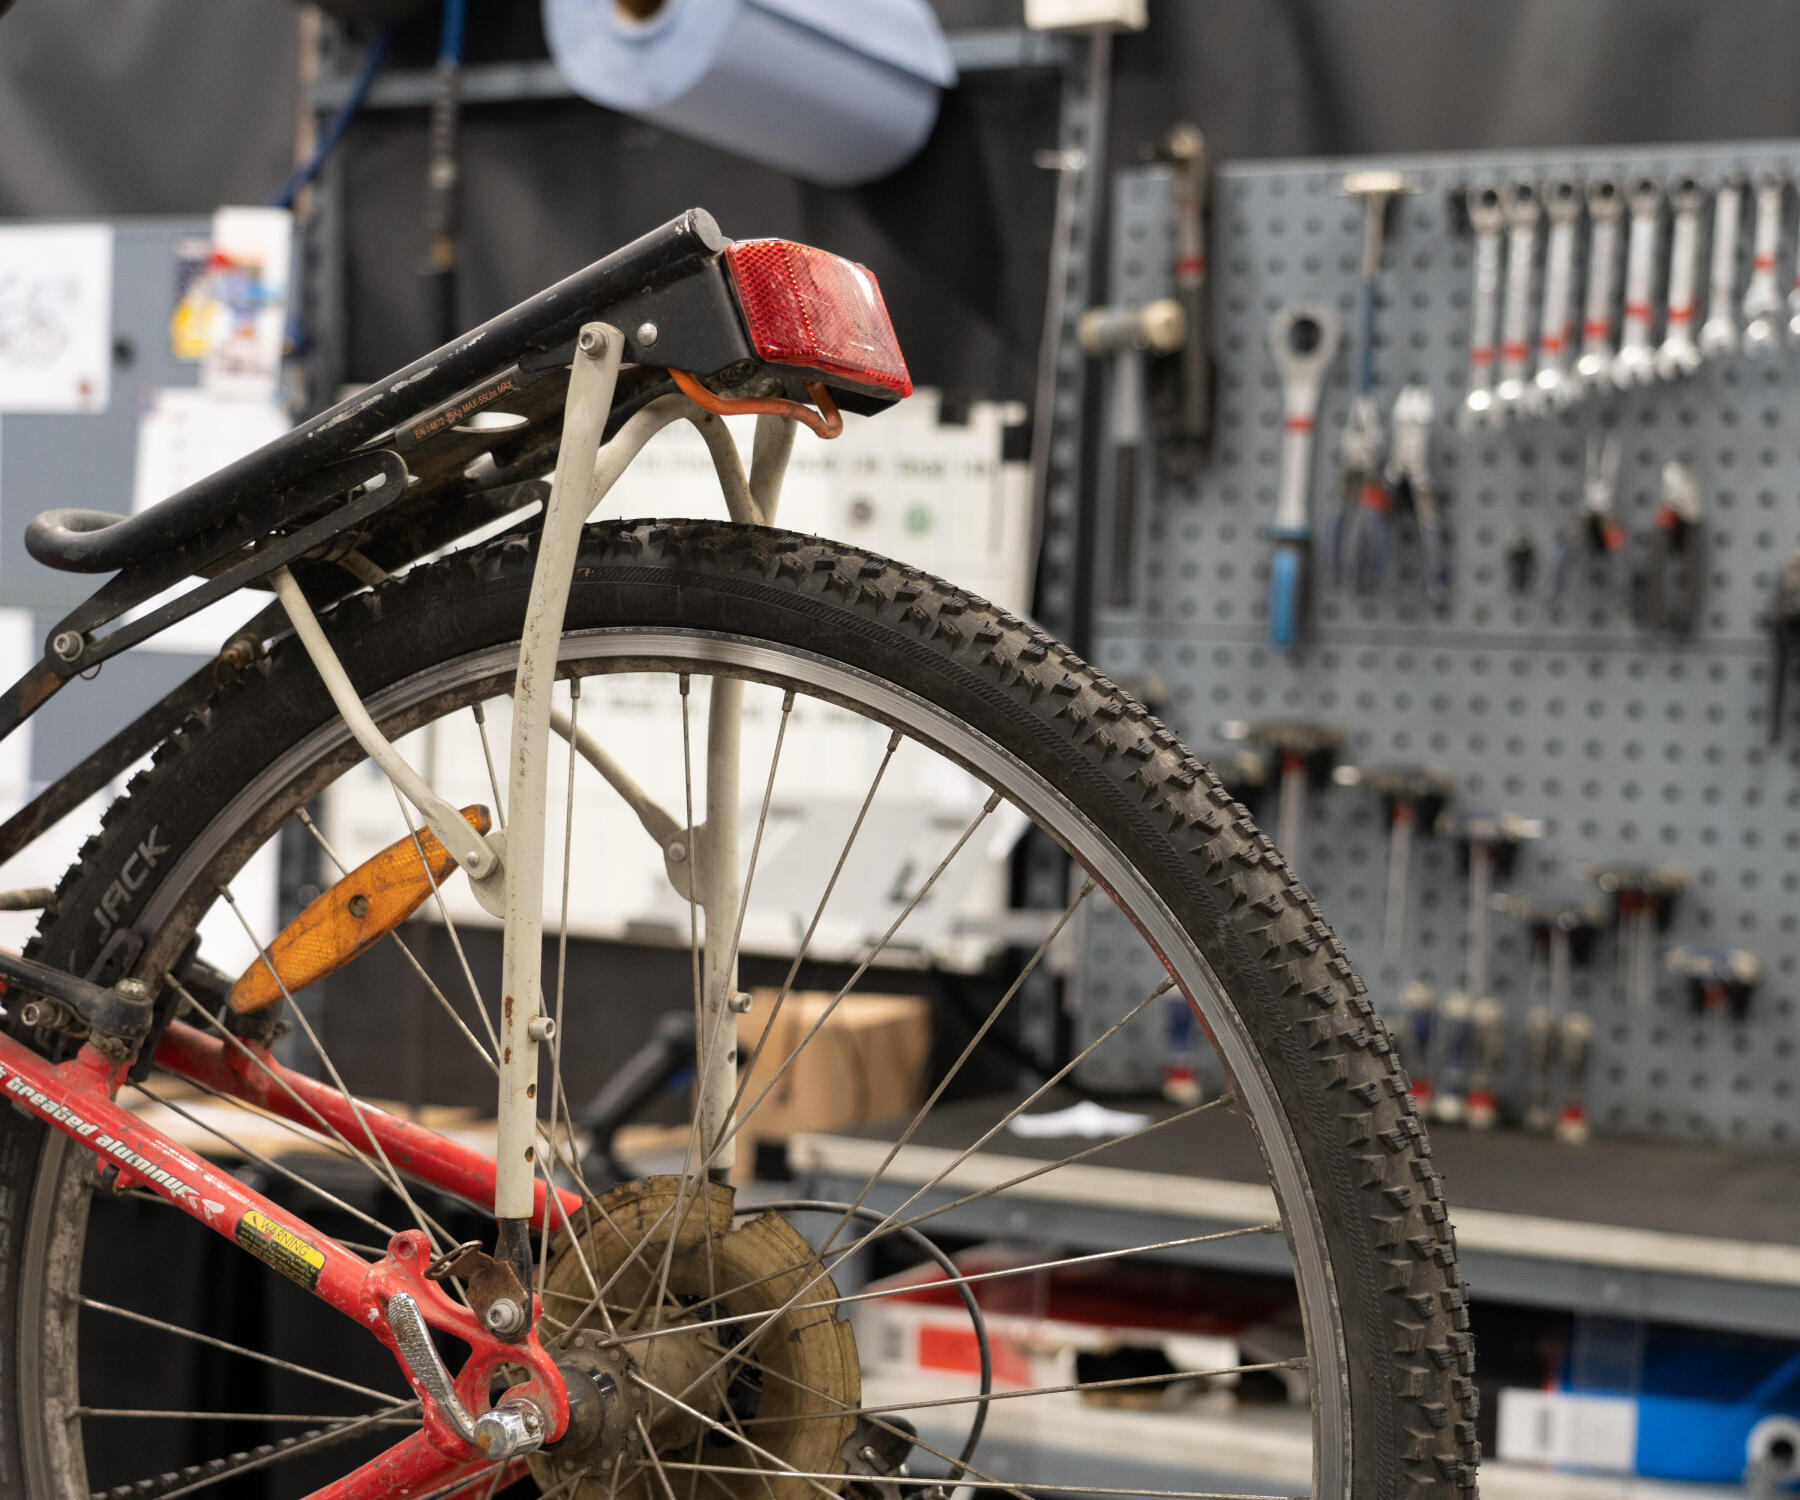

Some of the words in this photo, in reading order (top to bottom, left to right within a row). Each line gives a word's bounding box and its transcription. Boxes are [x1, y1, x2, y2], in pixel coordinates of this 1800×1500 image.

[93, 824, 171, 944] JACK
[5, 1076, 99, 1137] treated
[261, 1218, 310, 1257] WARNING
